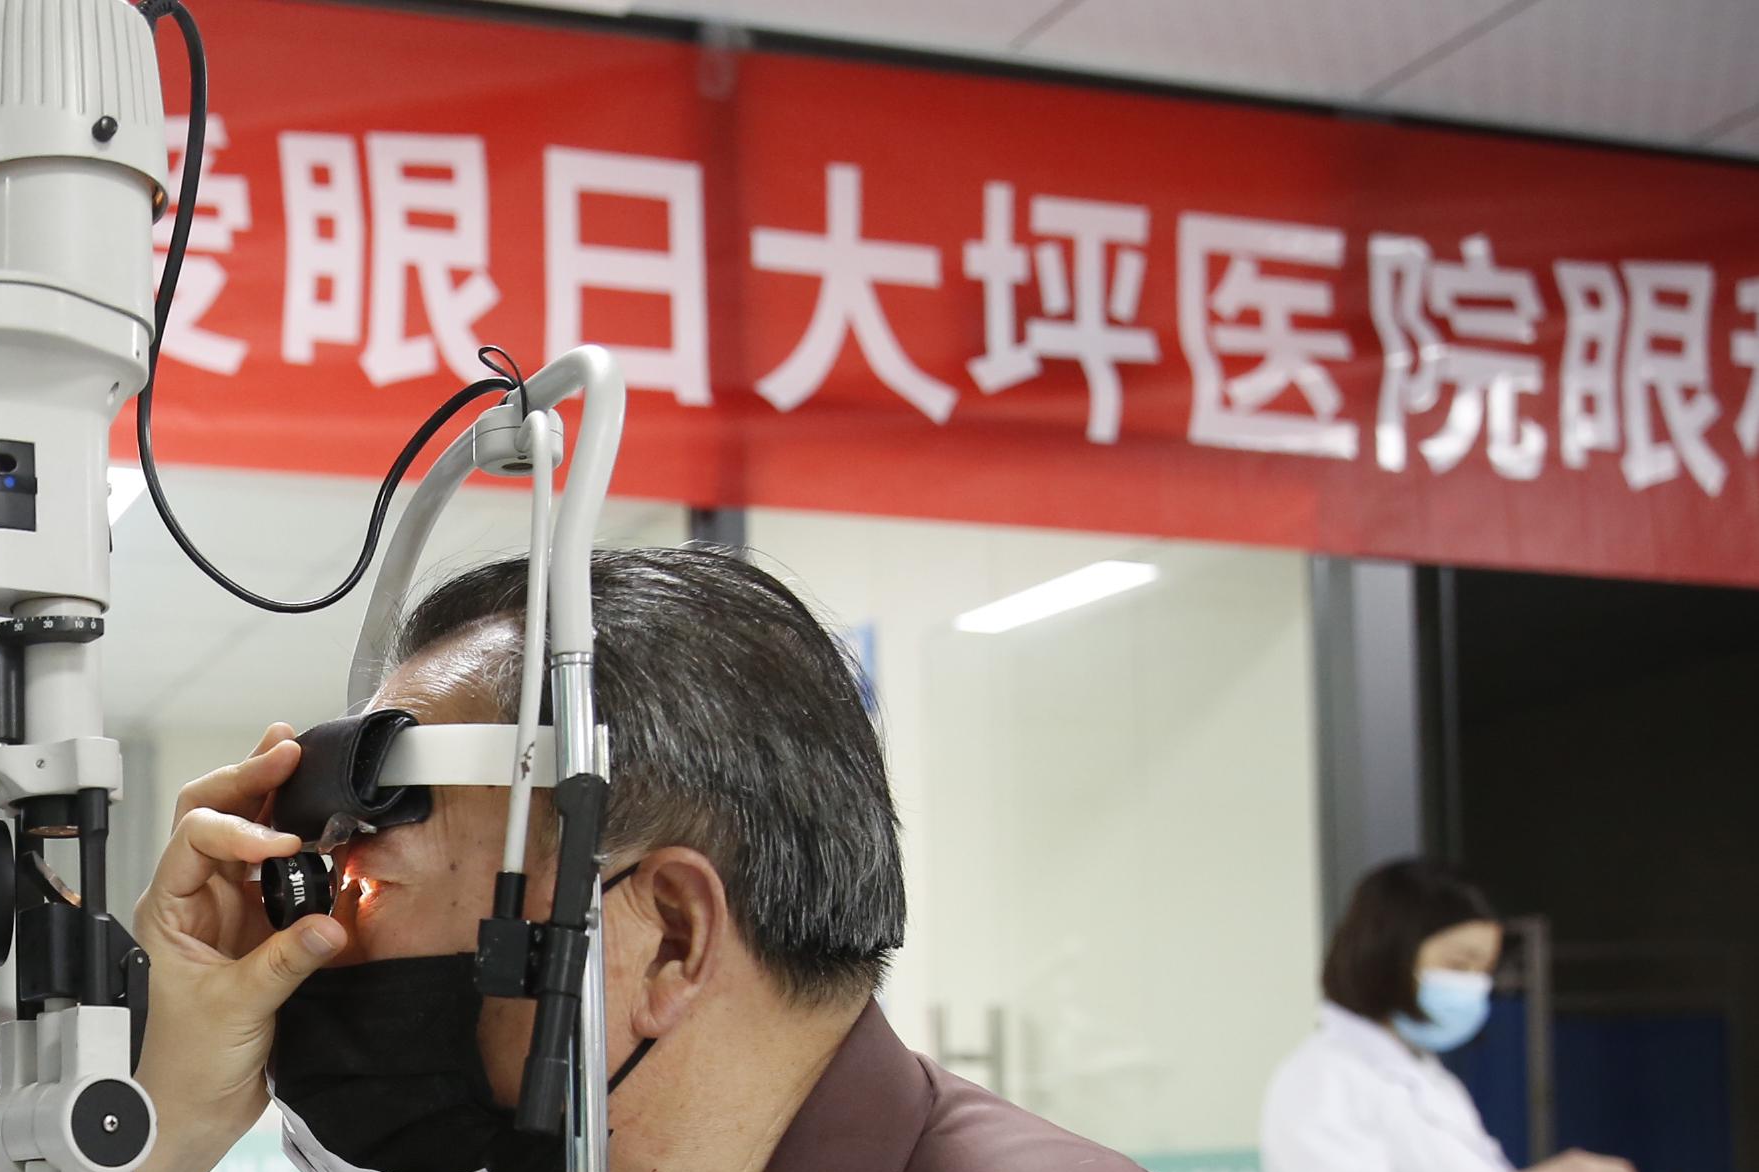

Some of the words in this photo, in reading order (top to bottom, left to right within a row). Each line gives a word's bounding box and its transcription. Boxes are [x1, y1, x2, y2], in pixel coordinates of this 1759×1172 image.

[14, 623, 23, 631] 50
[43, 621, 53, 629] 30
[74, 621, 84, 629] 10
[91, 621, 96, 629] 0
